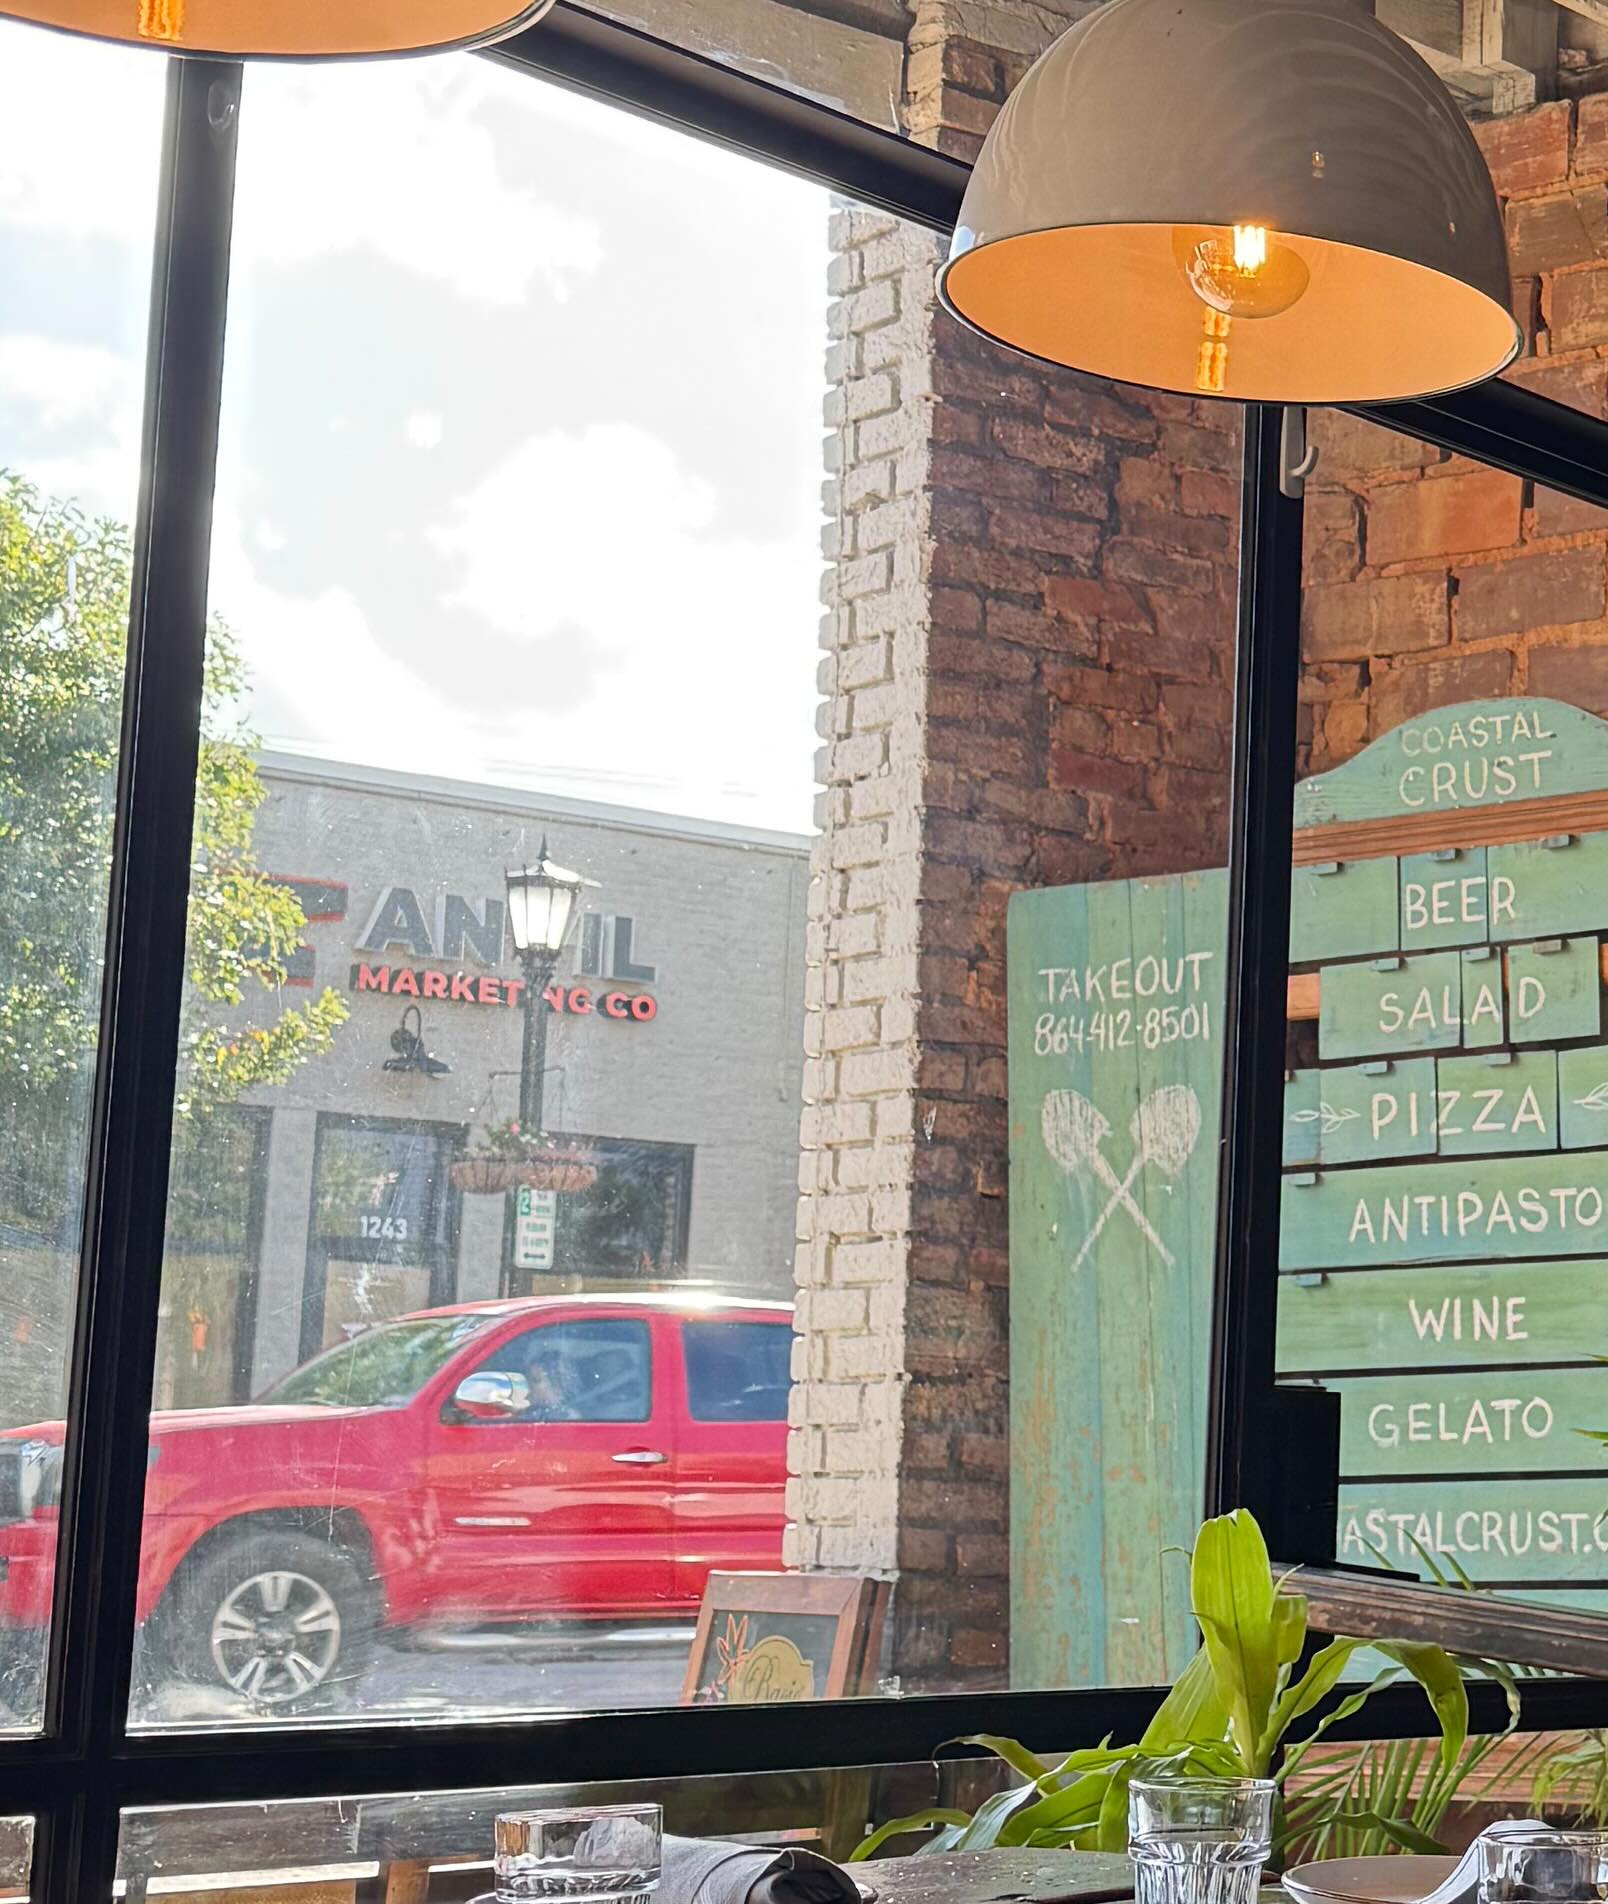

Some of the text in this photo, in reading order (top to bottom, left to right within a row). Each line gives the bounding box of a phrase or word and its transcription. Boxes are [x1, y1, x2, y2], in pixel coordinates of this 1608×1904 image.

[1402, 711, 1552, 757] COASTAL
[1400, 750, 1552, 806] CRUST
[1405, 876, 1516, 929] BEER
[352, 887, 657, 984] ANIL
[352, 962, 657, 1023] MARKETNG CO
[1038, 951, 1213, 1003] TAKEOUT
[1379, 976, 1546, 1033] SALAD
[1371, 1085, 1546, 1140] PIZZA
[360, 1215, 408, 1240] 1243
[1349, 1186, 1602, 1243] ANTIPASTO
[1408, 1296, 1528, 1341] WINE
[1368, 1397, 1553, 1446] GELATO
